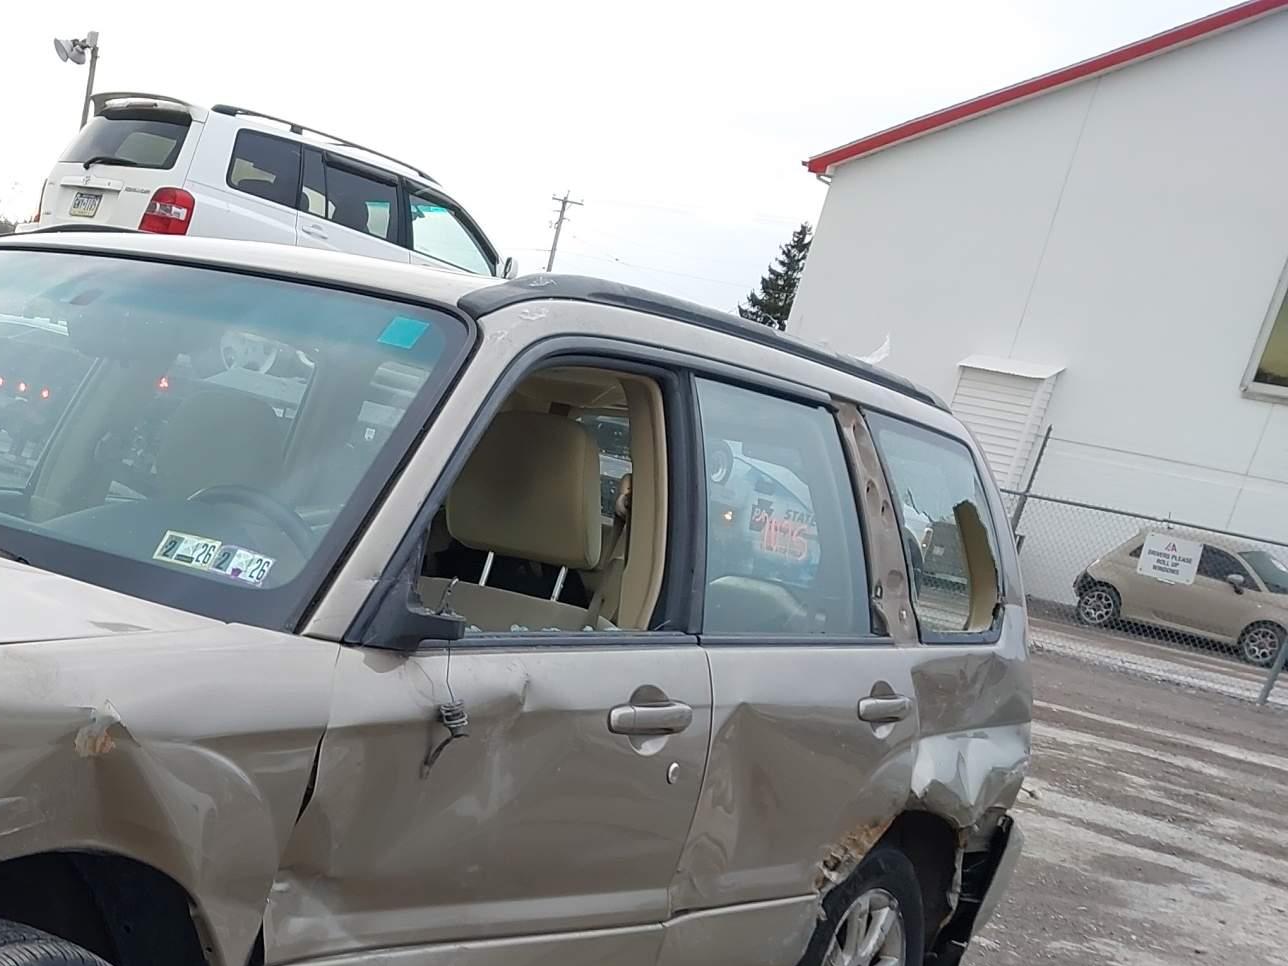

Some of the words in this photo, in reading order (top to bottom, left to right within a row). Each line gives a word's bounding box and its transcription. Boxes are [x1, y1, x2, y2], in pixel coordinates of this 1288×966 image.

[163, 540, 176, 557] 2
[194, 543, 216, 565] 26
[1148, 549, 1170, 559] DRIVERS
[1171, 554, 1192, 564] PLEASE
[216, 551, 230, 570] 2
[248, 558, 270, 581] 26
[1152, 564, 1179, 575] WINDOWS
[1156, 558, 1170, 567] ROLL
